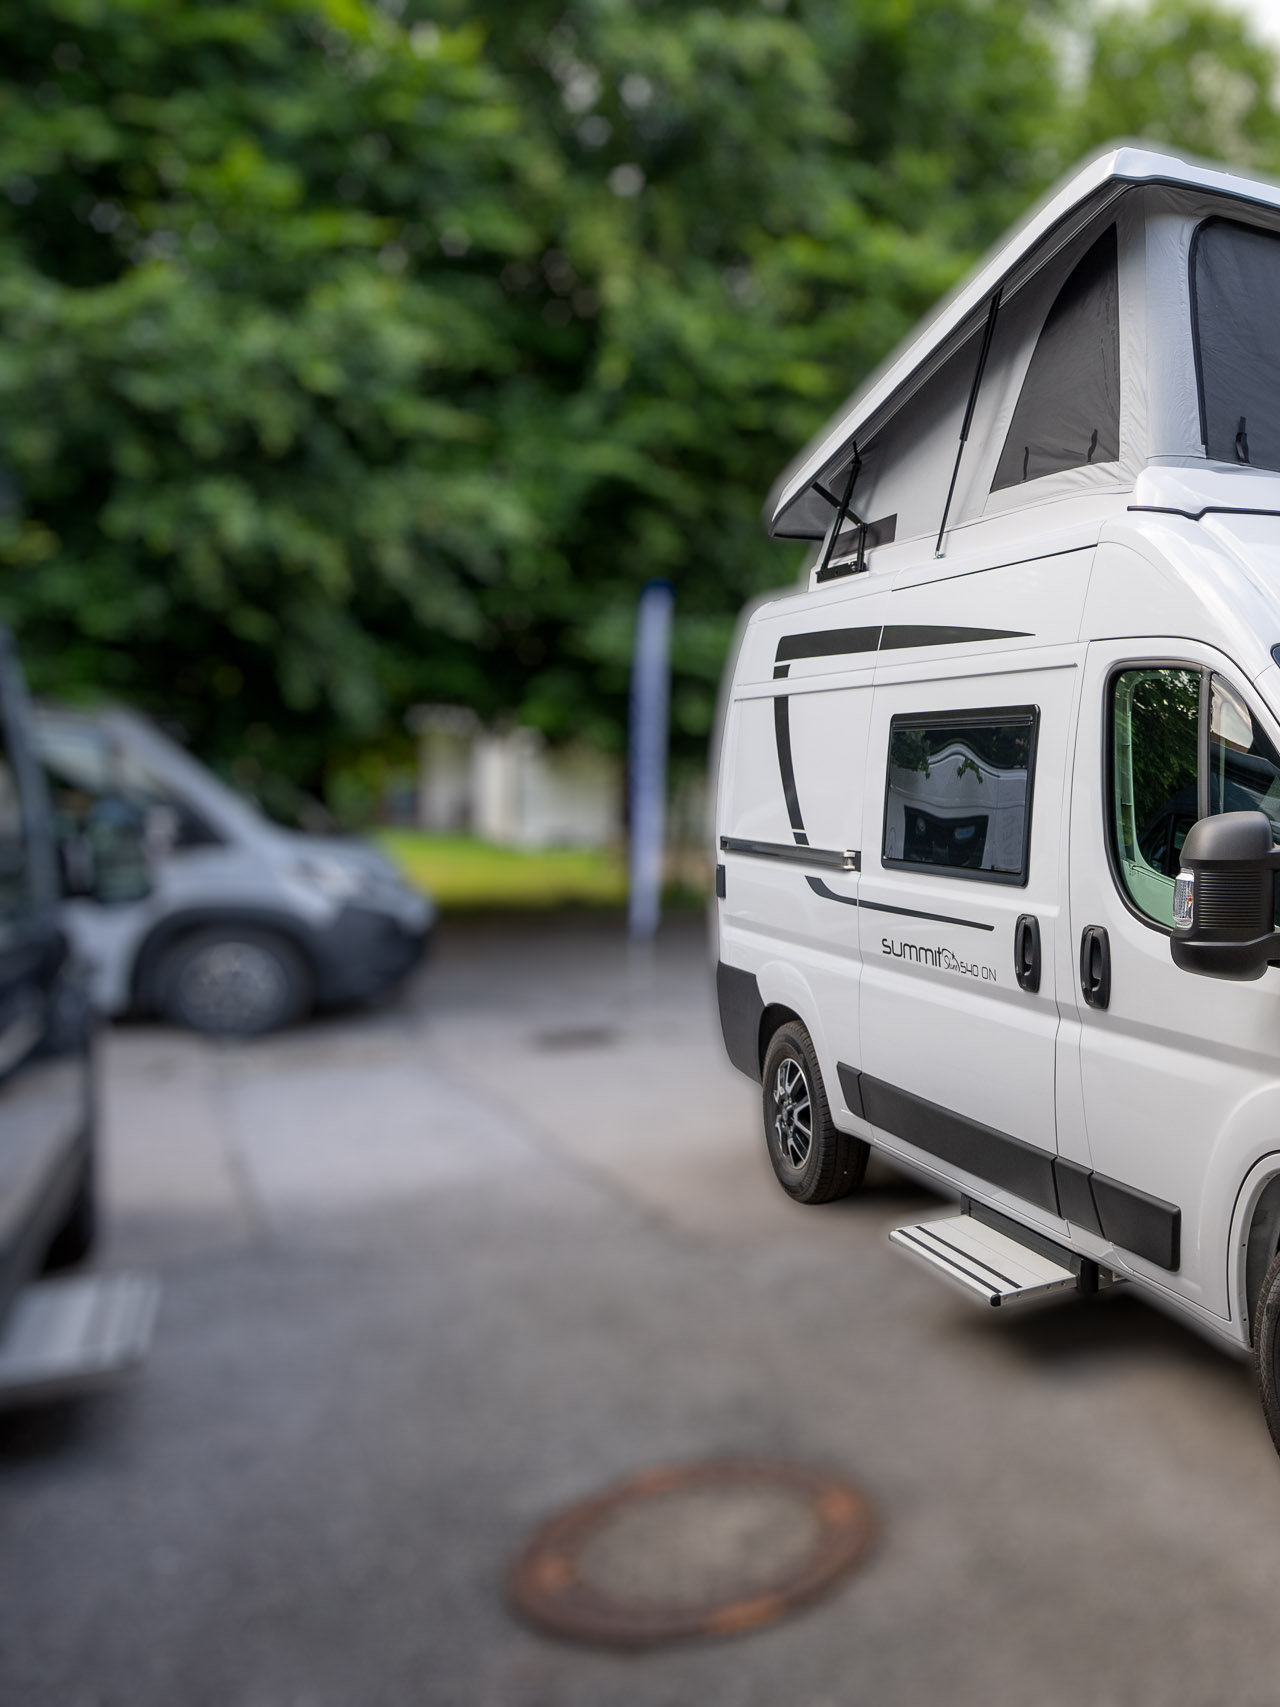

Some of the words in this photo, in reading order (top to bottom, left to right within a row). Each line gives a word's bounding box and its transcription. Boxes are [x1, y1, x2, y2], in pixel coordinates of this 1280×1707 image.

[881, 938, 942, 968] summit
[960, 961, 979, 977] 540
[981, 966, 997, 982] ON
